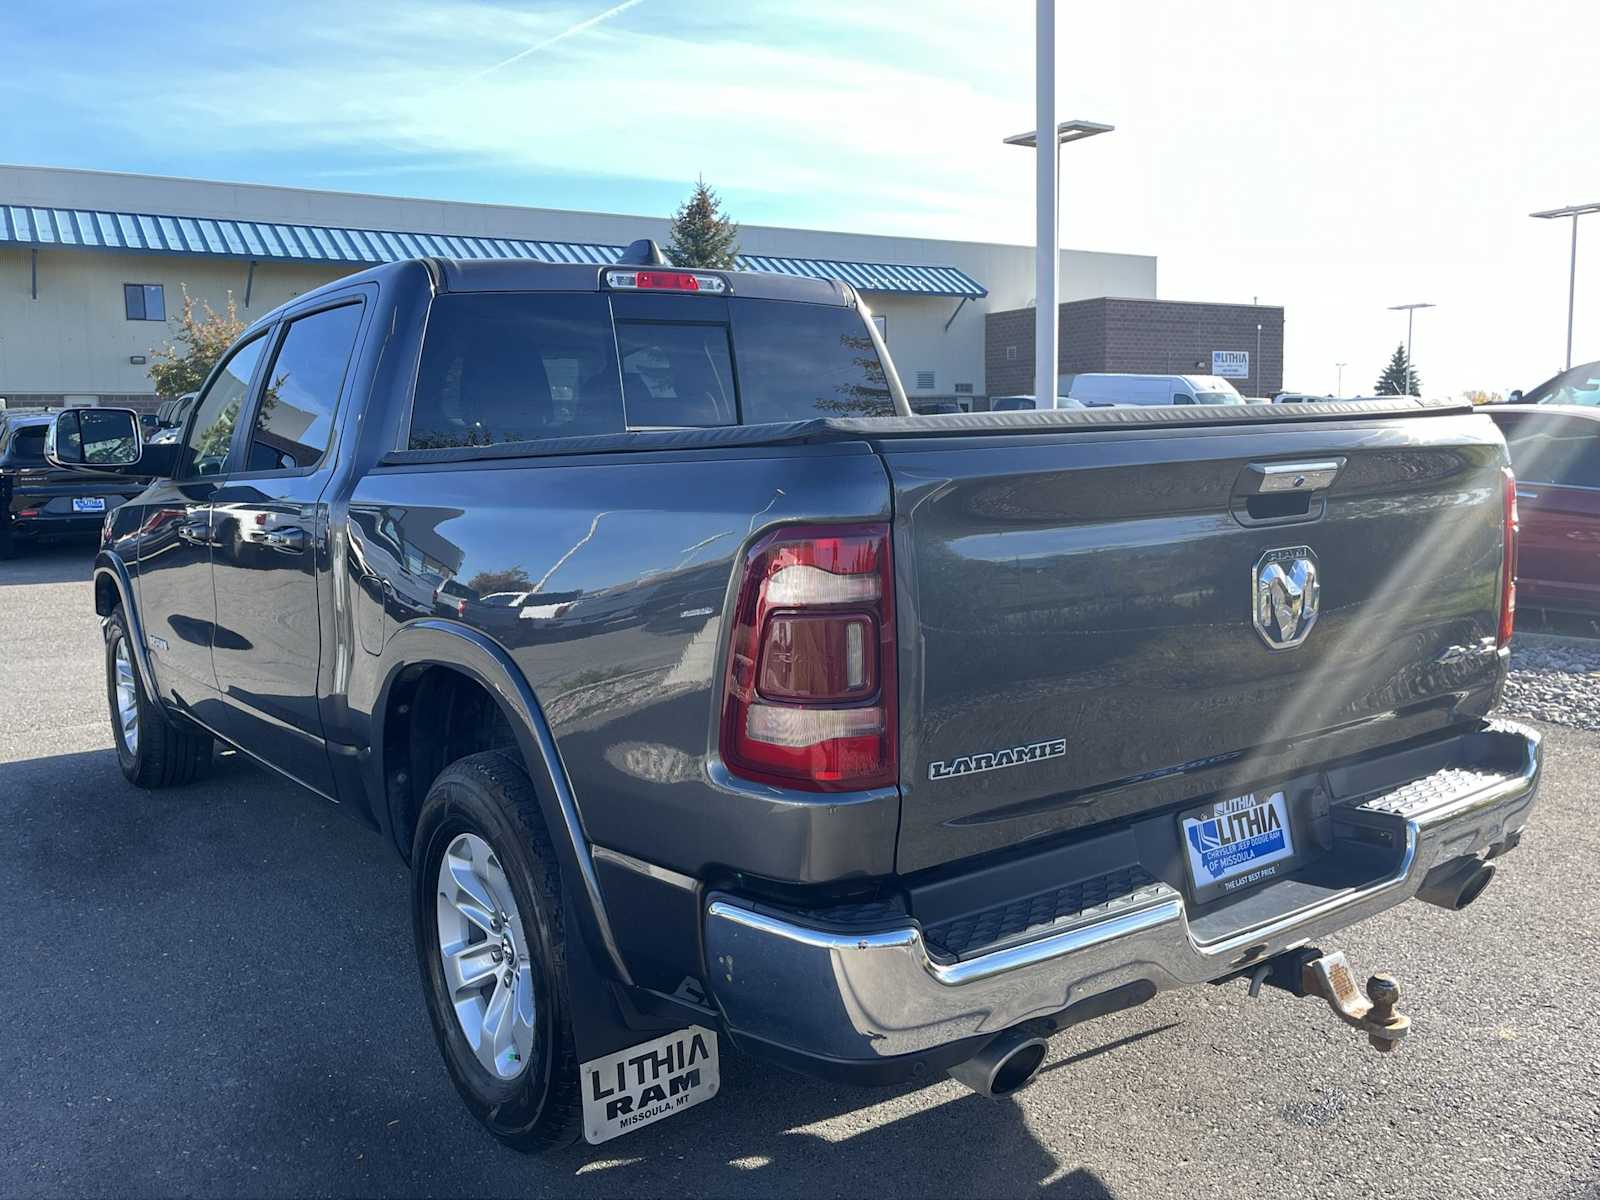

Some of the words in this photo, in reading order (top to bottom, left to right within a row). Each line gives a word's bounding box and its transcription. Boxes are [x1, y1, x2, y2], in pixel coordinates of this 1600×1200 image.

[1221, 352, 1247, 363] LITHIA
[1271, 548, 1308, 560] RAM
[928, 738, 1066, 780] LARAMIE
[1223, 793, 1256, 813] LITHIA
[1216, 803, 1282, 846] LITHIA
[1207, 845, 1237, 860] CHRYSLER
[1238, 841, 1251, 850] JEEP
[1251, 835, 1270, 846] DODGE
[1209, 859, 1220, 871] OF
[1221, 850, 1256, 868] MISSOULA
[1225, 881, 1237, 890] THE
[1236, 876, 1248, 887] LAST
[1248, 872, 1261, 882] BEST
[1261, 866, 1276, 878] PRICE
[592, 1033, 709, 1101] LITHIA
[606, 1068, 701, 1121] RAM
[620, 1102, 674, 1128] MISSOULA,
[676, 1094, 690, 1107] MT
